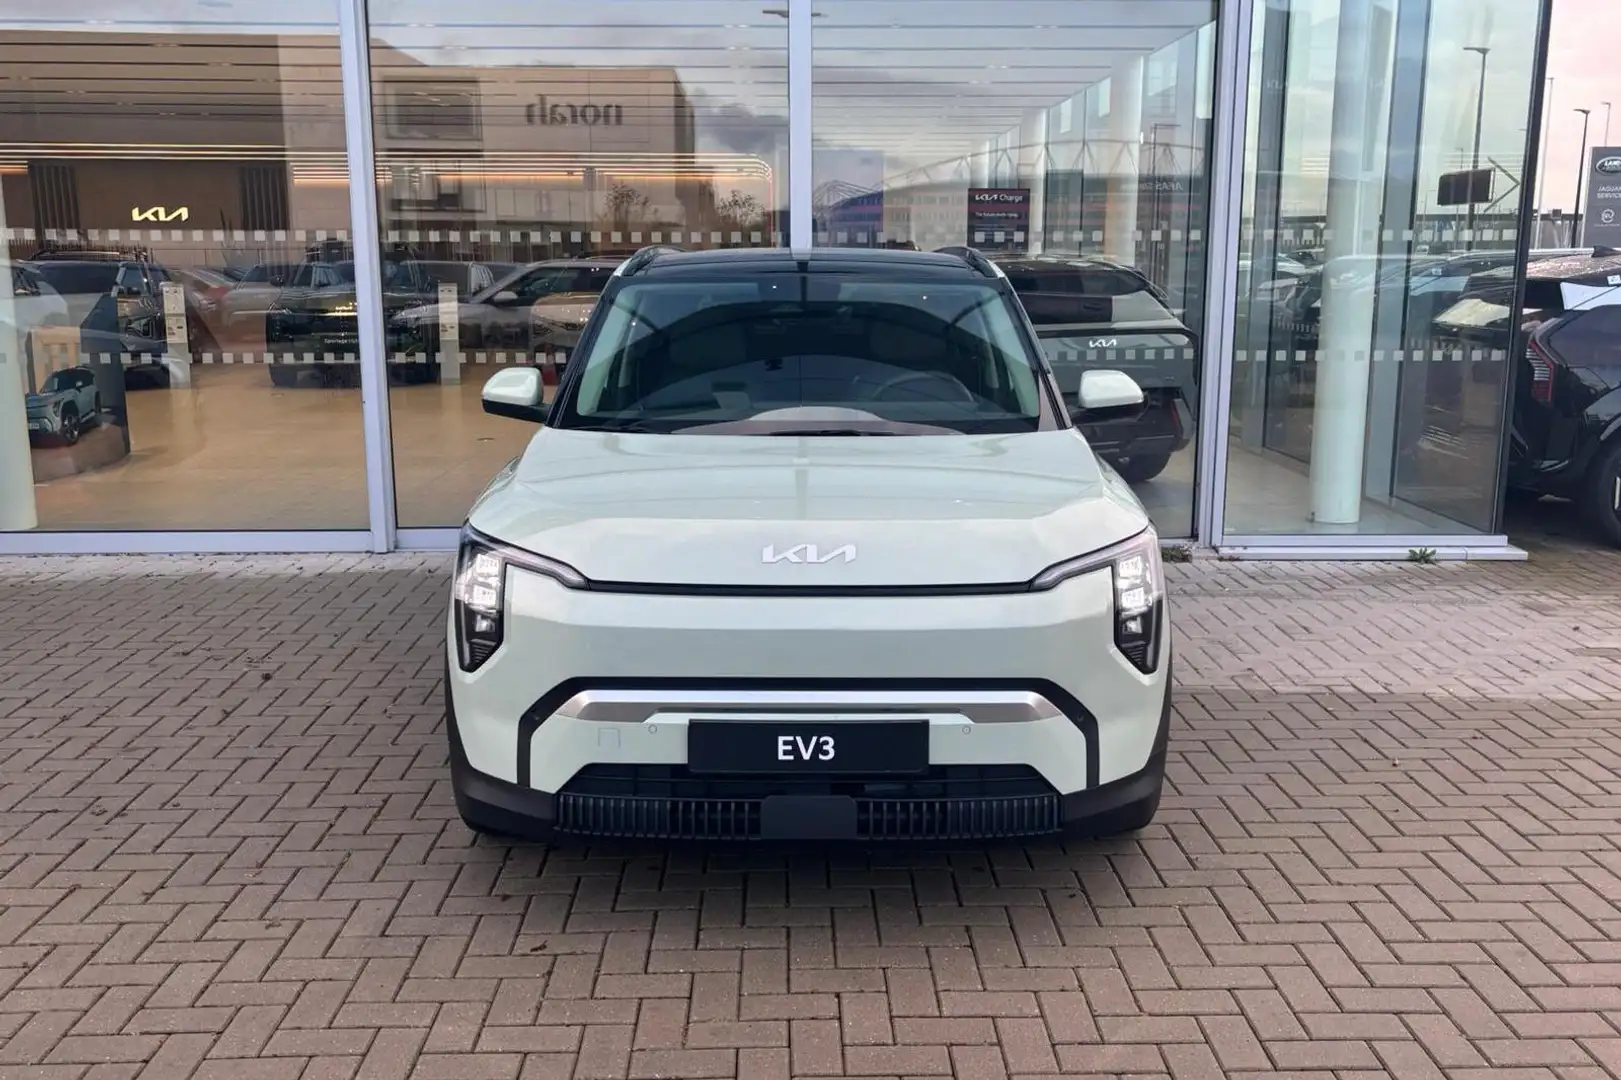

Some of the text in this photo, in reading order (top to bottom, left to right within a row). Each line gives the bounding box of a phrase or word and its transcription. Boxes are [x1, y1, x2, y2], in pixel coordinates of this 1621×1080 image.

[975, 193, 1023, 203] KIA Charge
[131, 206, 189, 221] KIA
[1088, 339, 1117, 348] KIA
[762, 543, 857, 564] KIA
[777, 735, 835, 761] EV3
